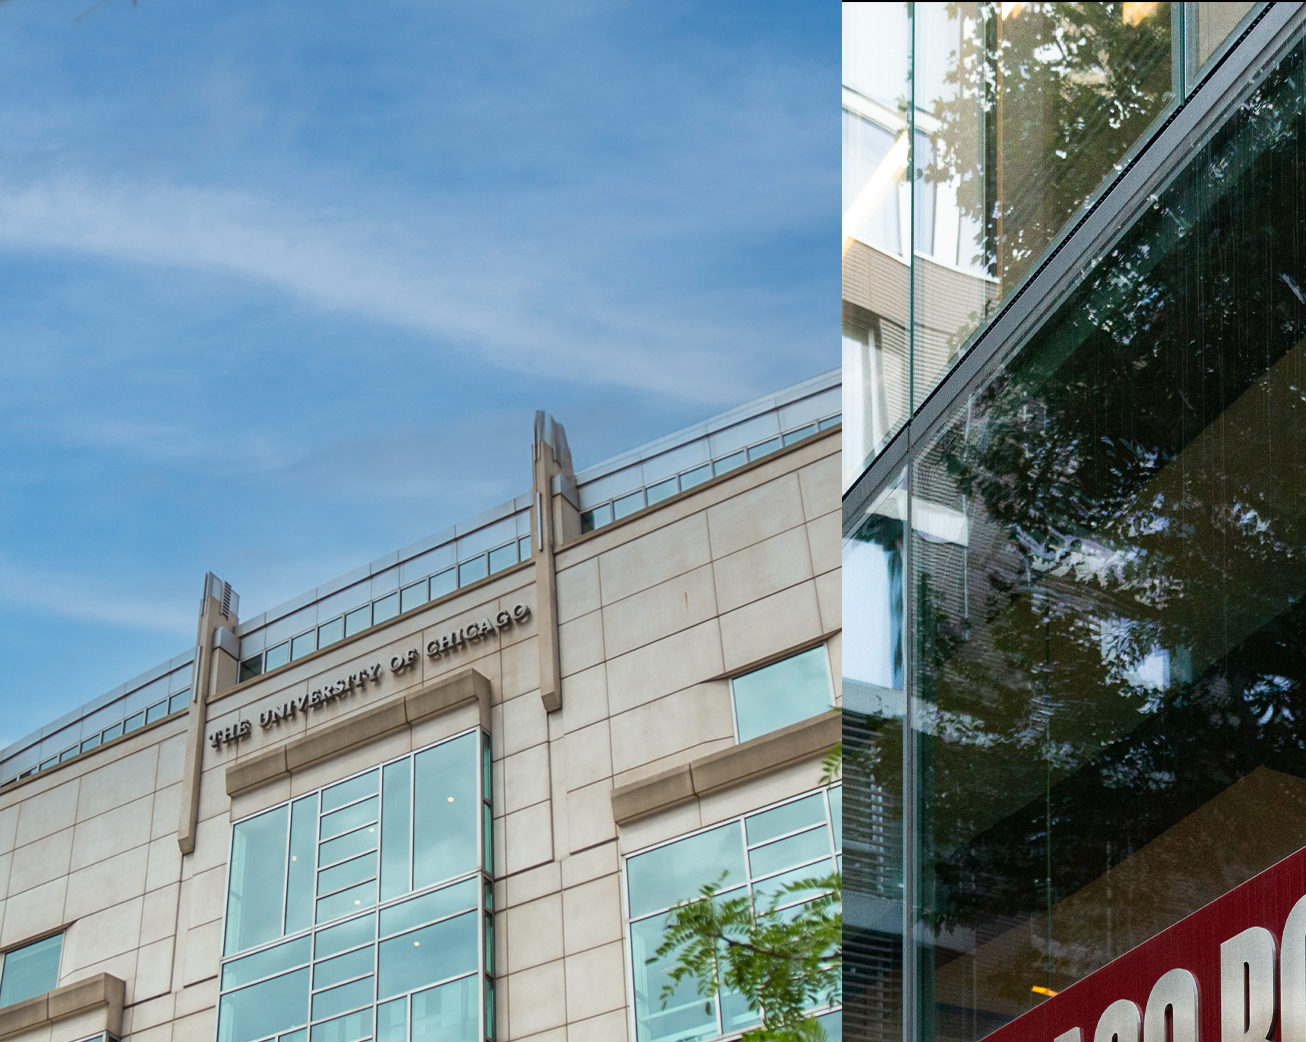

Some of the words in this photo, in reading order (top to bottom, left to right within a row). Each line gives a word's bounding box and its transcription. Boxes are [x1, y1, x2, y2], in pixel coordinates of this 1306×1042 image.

[209, 719, 252, 748] THE
[258, 663, 381, 728] UNIVERSITY
[389, 648, 419, 674] OF
[426, 602, 532, 658] CHICAGO
